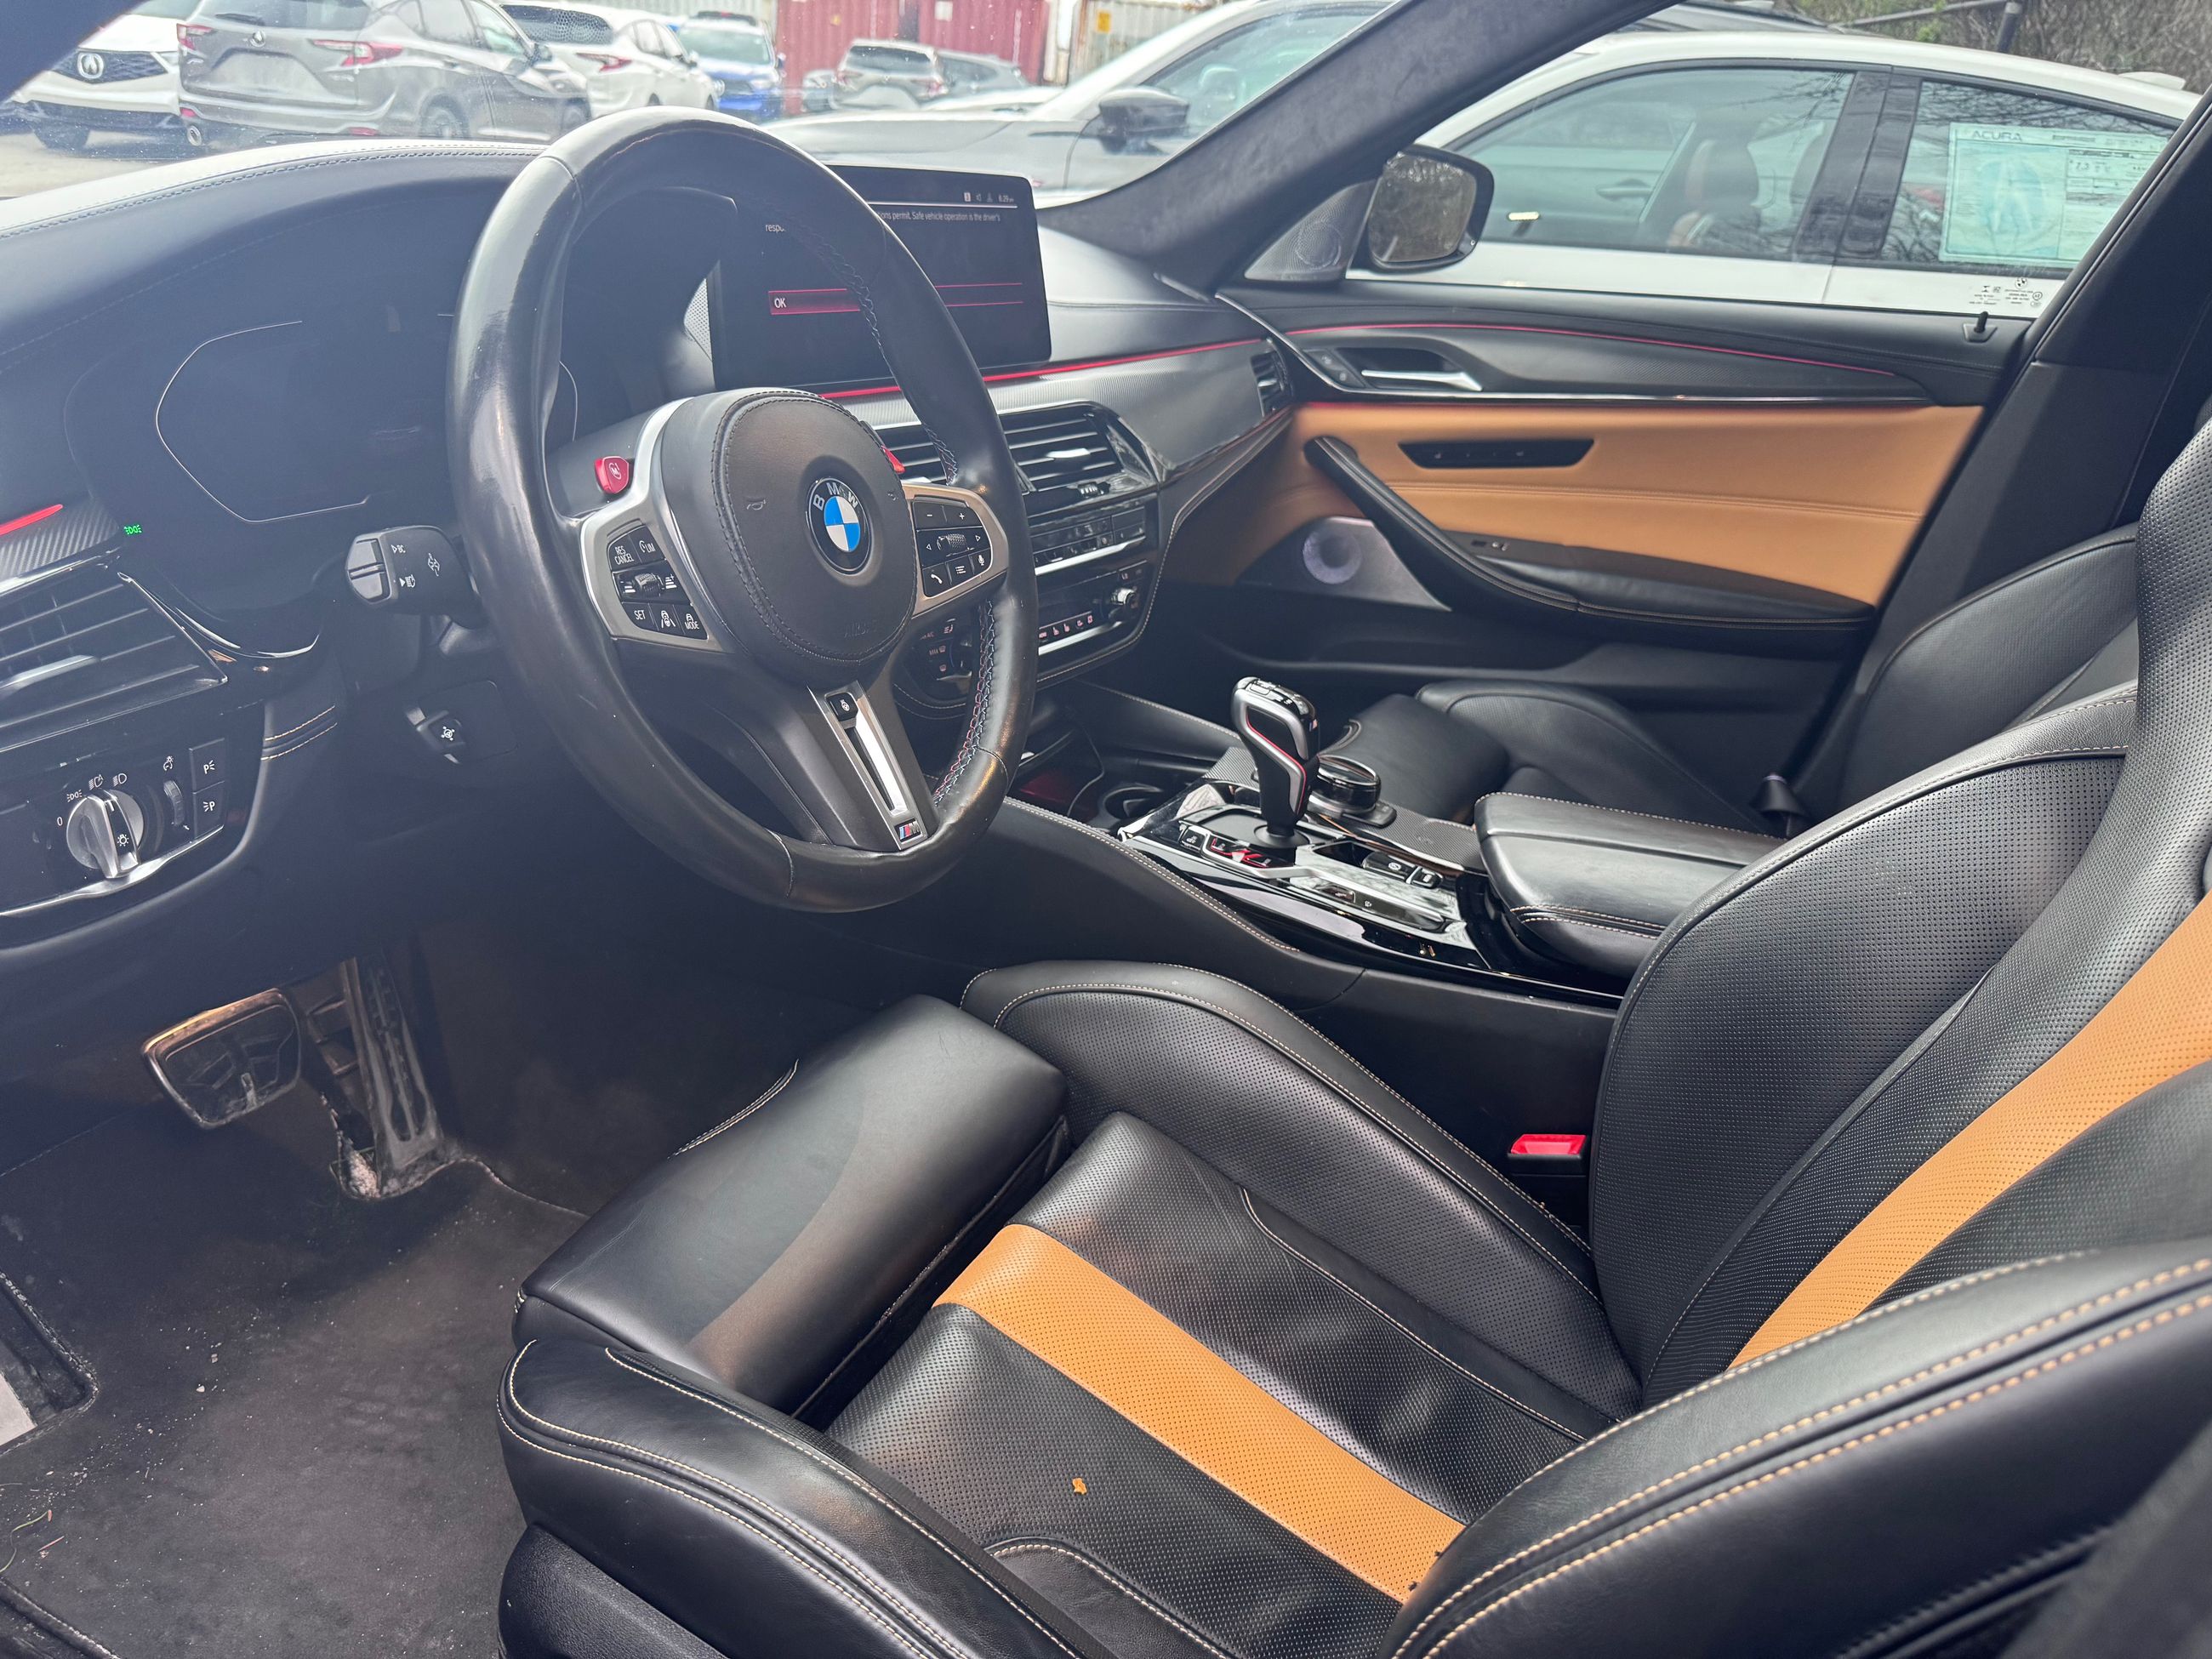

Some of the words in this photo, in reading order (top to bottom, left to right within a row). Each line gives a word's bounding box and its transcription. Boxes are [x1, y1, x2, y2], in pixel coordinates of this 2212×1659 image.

[1971, 129, 2023, 142] ACURA
[912, 211, 924, 221] Safe
[925, 211, 943, 221] vehicle
[944, 213, 967, 222] operation
[973, 213, 982, 222] the
[774, 298, 787, 308] OK
[812, 482, 859, 511] BMW
[614, 545, 626, 556] RES
[614, 553, 635, 565] CANCEL
[634, 609, 646, 620] SET
[684, 621, 700, 630] MODE
